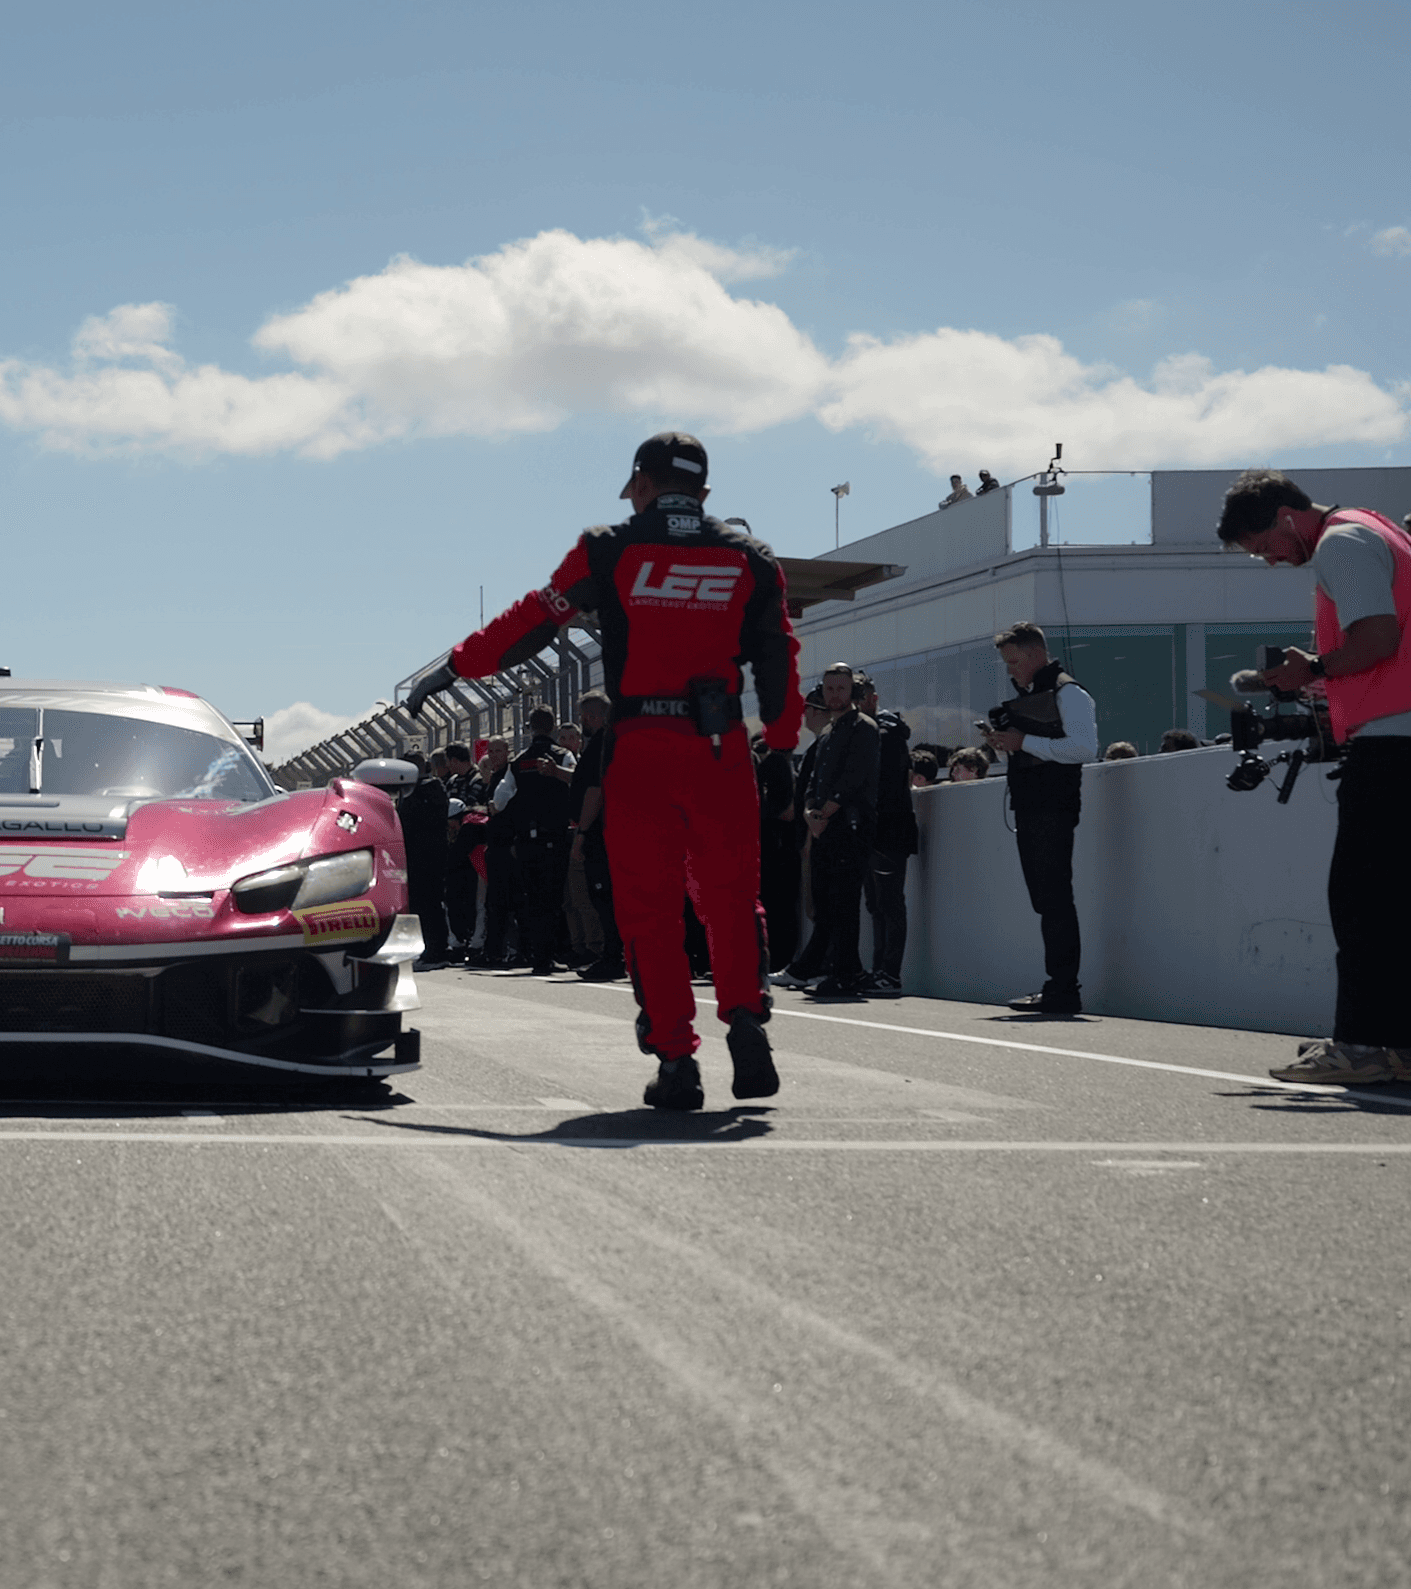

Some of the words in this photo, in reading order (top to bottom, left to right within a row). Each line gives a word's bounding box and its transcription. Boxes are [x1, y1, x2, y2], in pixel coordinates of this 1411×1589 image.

[667, 518, 701, 531] OMP
[630, 561, 743, 602] LEE
[302, 906, 376, 936] PIRELLI
[25, 935, 58, 946] CORSA
